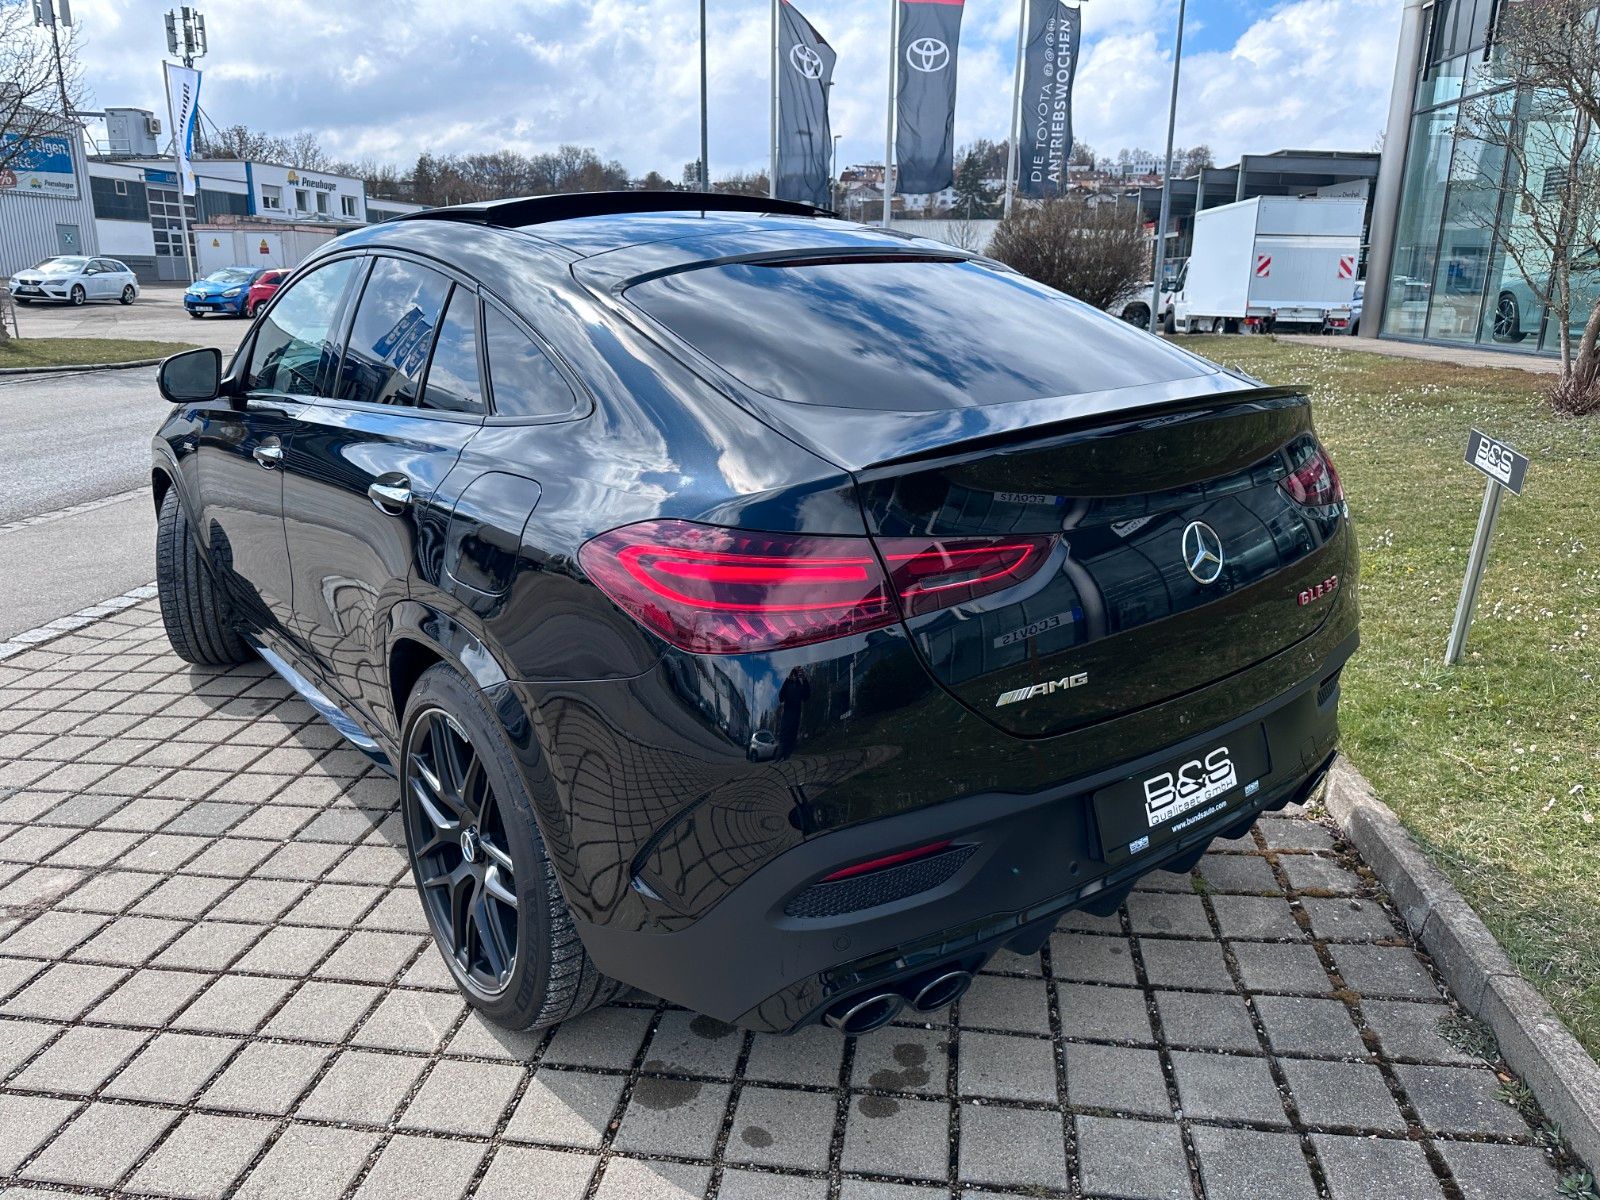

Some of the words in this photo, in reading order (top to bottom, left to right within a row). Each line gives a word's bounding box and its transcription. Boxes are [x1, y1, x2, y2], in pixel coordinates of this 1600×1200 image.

[1035, 83, 1053, 150] TOYOTA
[1047, 18, 1071, 183] ANTRIEBSWOCHEN
[302, 177, 337, 192] Pneuhage
[1030, 155, 1045, 183] DIE
[1477, 437, 1514, 475] B&S
[1297, 584, 1324, 607] GLE
[1322, 575, 1339, 593] 53
[1026, 671, 1088, 700] AMG
[1143, 746, 1233, 814] B&S
[1151, 794, 1202, 825] Qualitaet
[1204, 778, 1234, 800] GmbH
[1171, 800, 1228, 833] www.bundsauto.com
